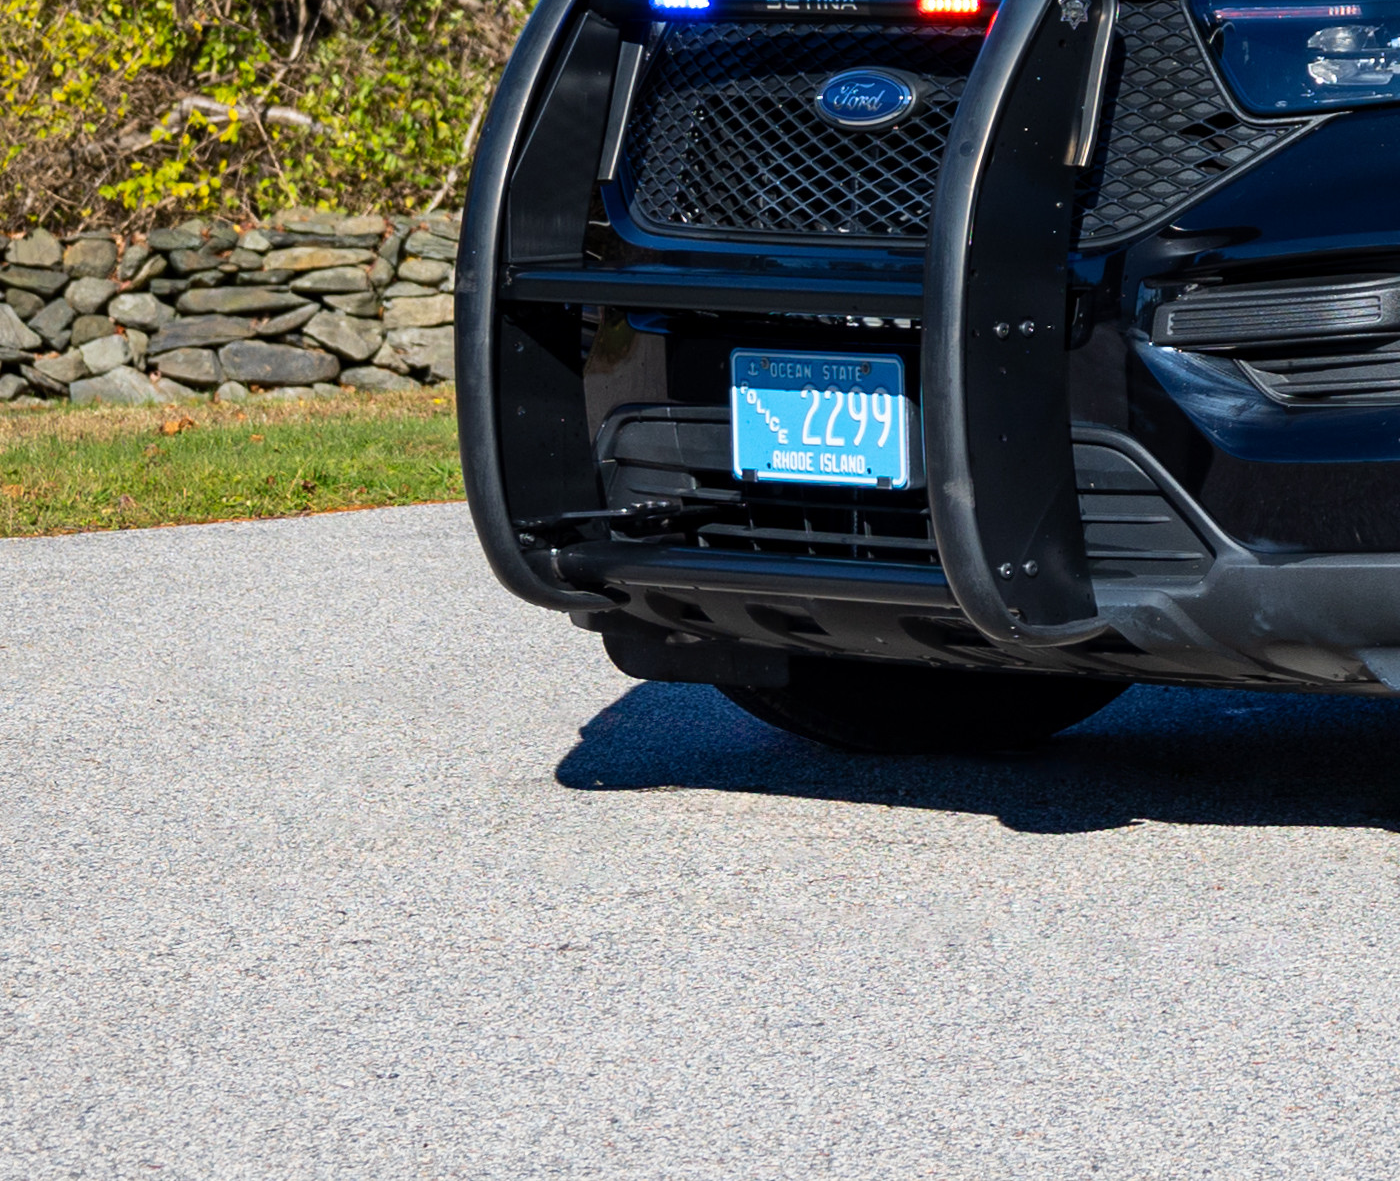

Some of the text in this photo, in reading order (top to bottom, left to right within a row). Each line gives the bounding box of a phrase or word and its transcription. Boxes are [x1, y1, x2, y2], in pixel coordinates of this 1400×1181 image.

[833, 82, 886, 111] Ford
[770, 362, 862, 381] OCEAN STATE
[740, 381, 789, 444] POLICE
[800, 383, 892, 447] 2299
[772, 450, 866, 474] RHODE ISLAND
